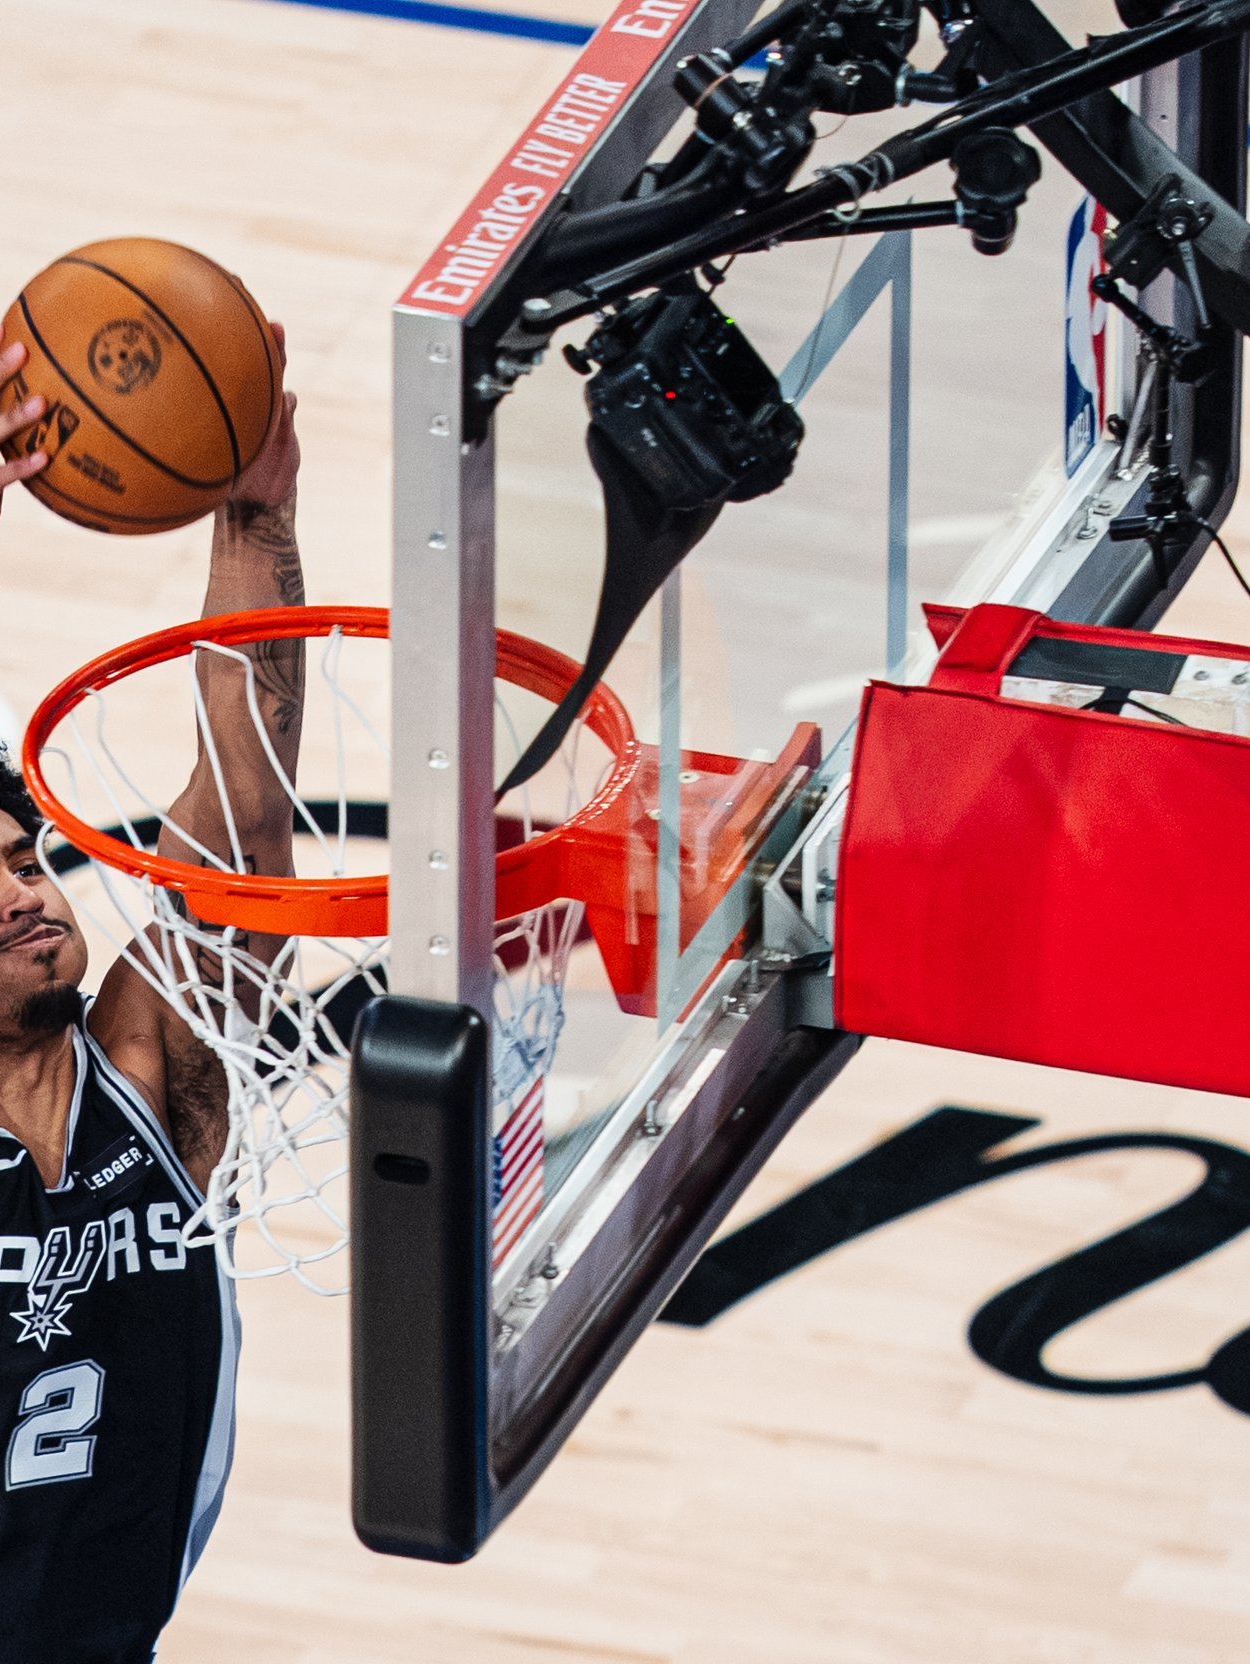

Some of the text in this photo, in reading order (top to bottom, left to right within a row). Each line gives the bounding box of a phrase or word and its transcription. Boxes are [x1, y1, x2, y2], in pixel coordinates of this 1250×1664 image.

[412, 73, 627, 306] Emirates FLY BETTER
[85, 1147, 143, 1191] LEDGER
[5, 1359, 107, 1492] 2
